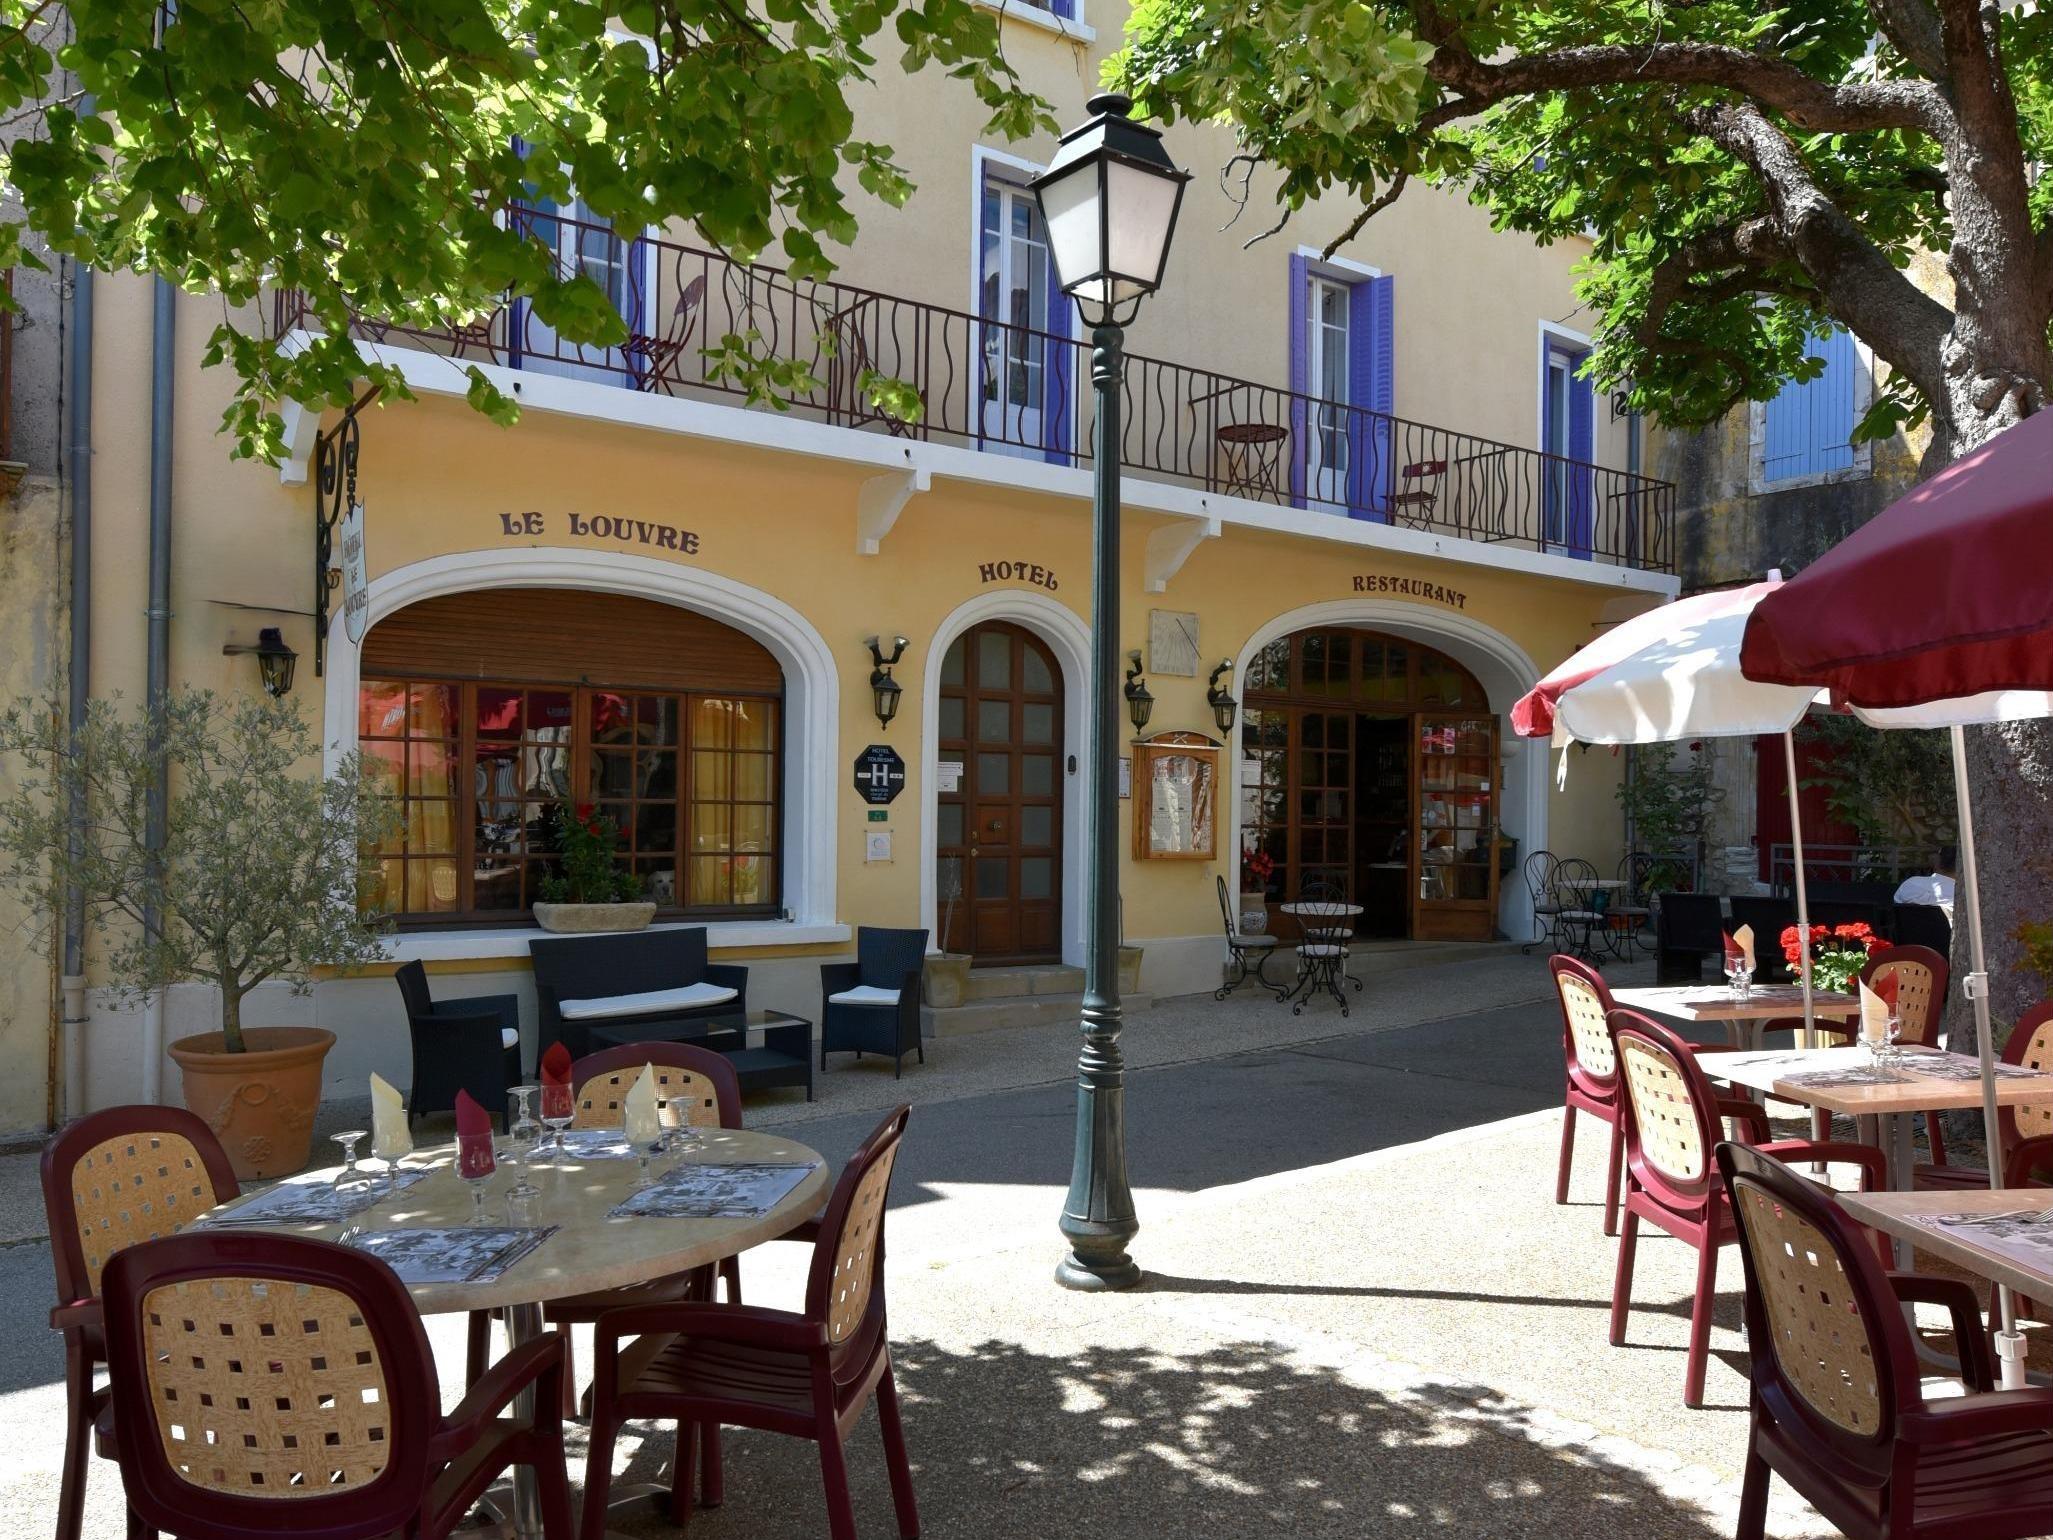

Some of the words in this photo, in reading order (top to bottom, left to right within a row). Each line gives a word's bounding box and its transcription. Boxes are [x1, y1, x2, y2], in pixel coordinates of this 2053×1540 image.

[499, 512, 545, 536] LE
[568, 512, 701, 555] LOUVRE
[979, 561, 1058, 591] HOTEL
[345, 588, 367, 617] LOUVRE
[1353, 574, 1467, 610] RESTAURANT
[872, 764, 888, 786] H
